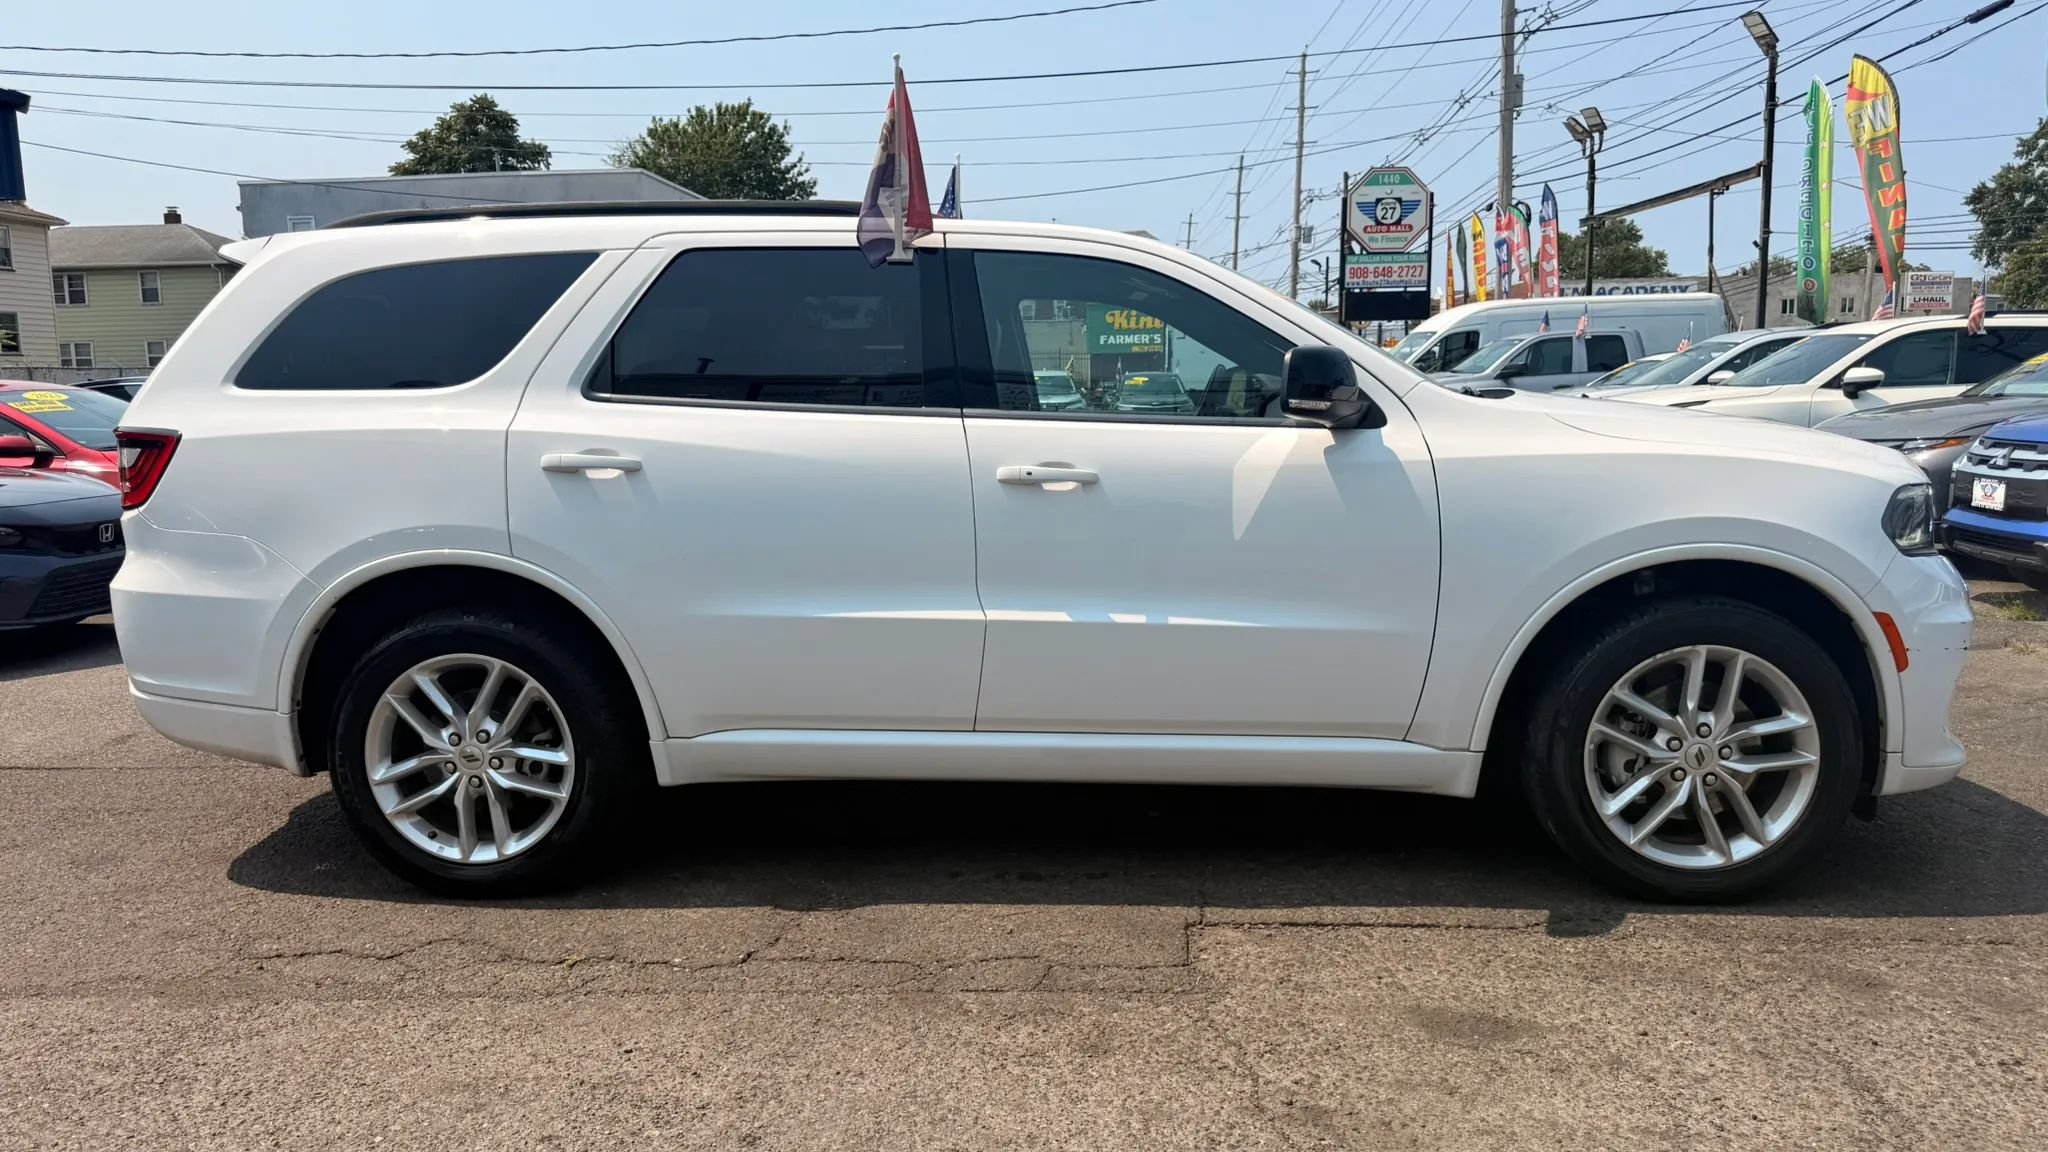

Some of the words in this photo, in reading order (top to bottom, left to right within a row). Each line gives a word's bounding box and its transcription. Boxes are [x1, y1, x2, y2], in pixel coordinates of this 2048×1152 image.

[1378, 174, 1400, 185] 1440
[1380, 206, 1396, 220] 27
[1366, 225, 1387, 233] AUTO
[1368, 236, 1379, 244] We
[1381, 235, 1409, 243] Finance
[1349, 265, 1424, 279] 908-648-2727
[1595, 285, 1690, 296] ACADEMY
[1100, 334, 1161, 345] FARMER'S
